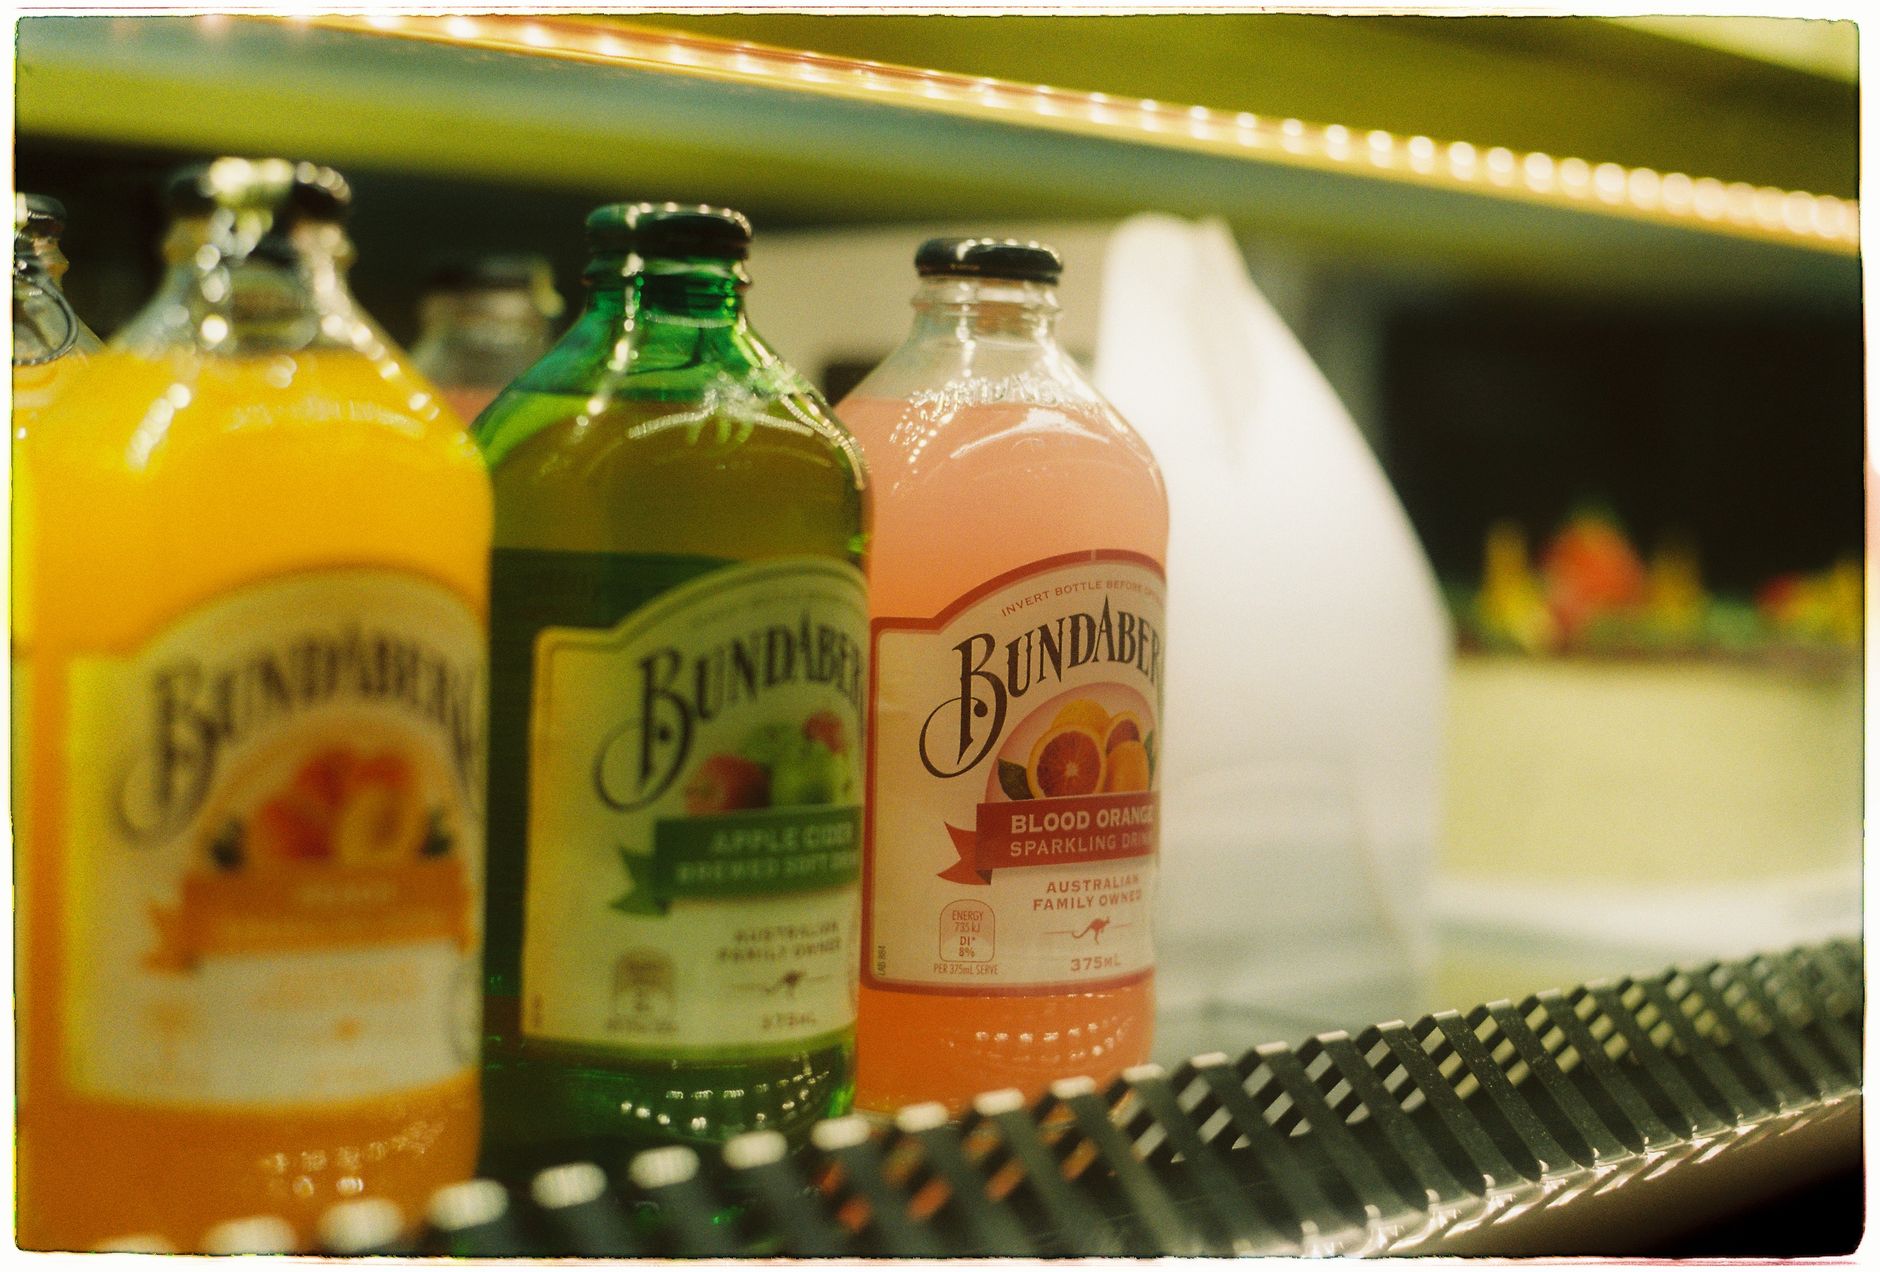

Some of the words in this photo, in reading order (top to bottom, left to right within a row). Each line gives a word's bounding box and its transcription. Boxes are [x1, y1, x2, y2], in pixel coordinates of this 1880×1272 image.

[1001, 591, 1051, 617] INVERT
[1055, 580, 1103, 597] BOTTLE
[918, 593, 1160, 778] BUNDABER
[1011, 810, 1090, 834] BLOOD
[1009, 833, 1117, 858] SPARKLING
[1046, 873, 1140, 894] AUSTRALIAN
[1032, 895, 1094, 912] FAMILY
[952, 910, 984, 921] ENERGY
[958, 947, 976, 958] 8%
[933, 963, 948, 974] PER
[975, 963, 1000, 975] SERVE
